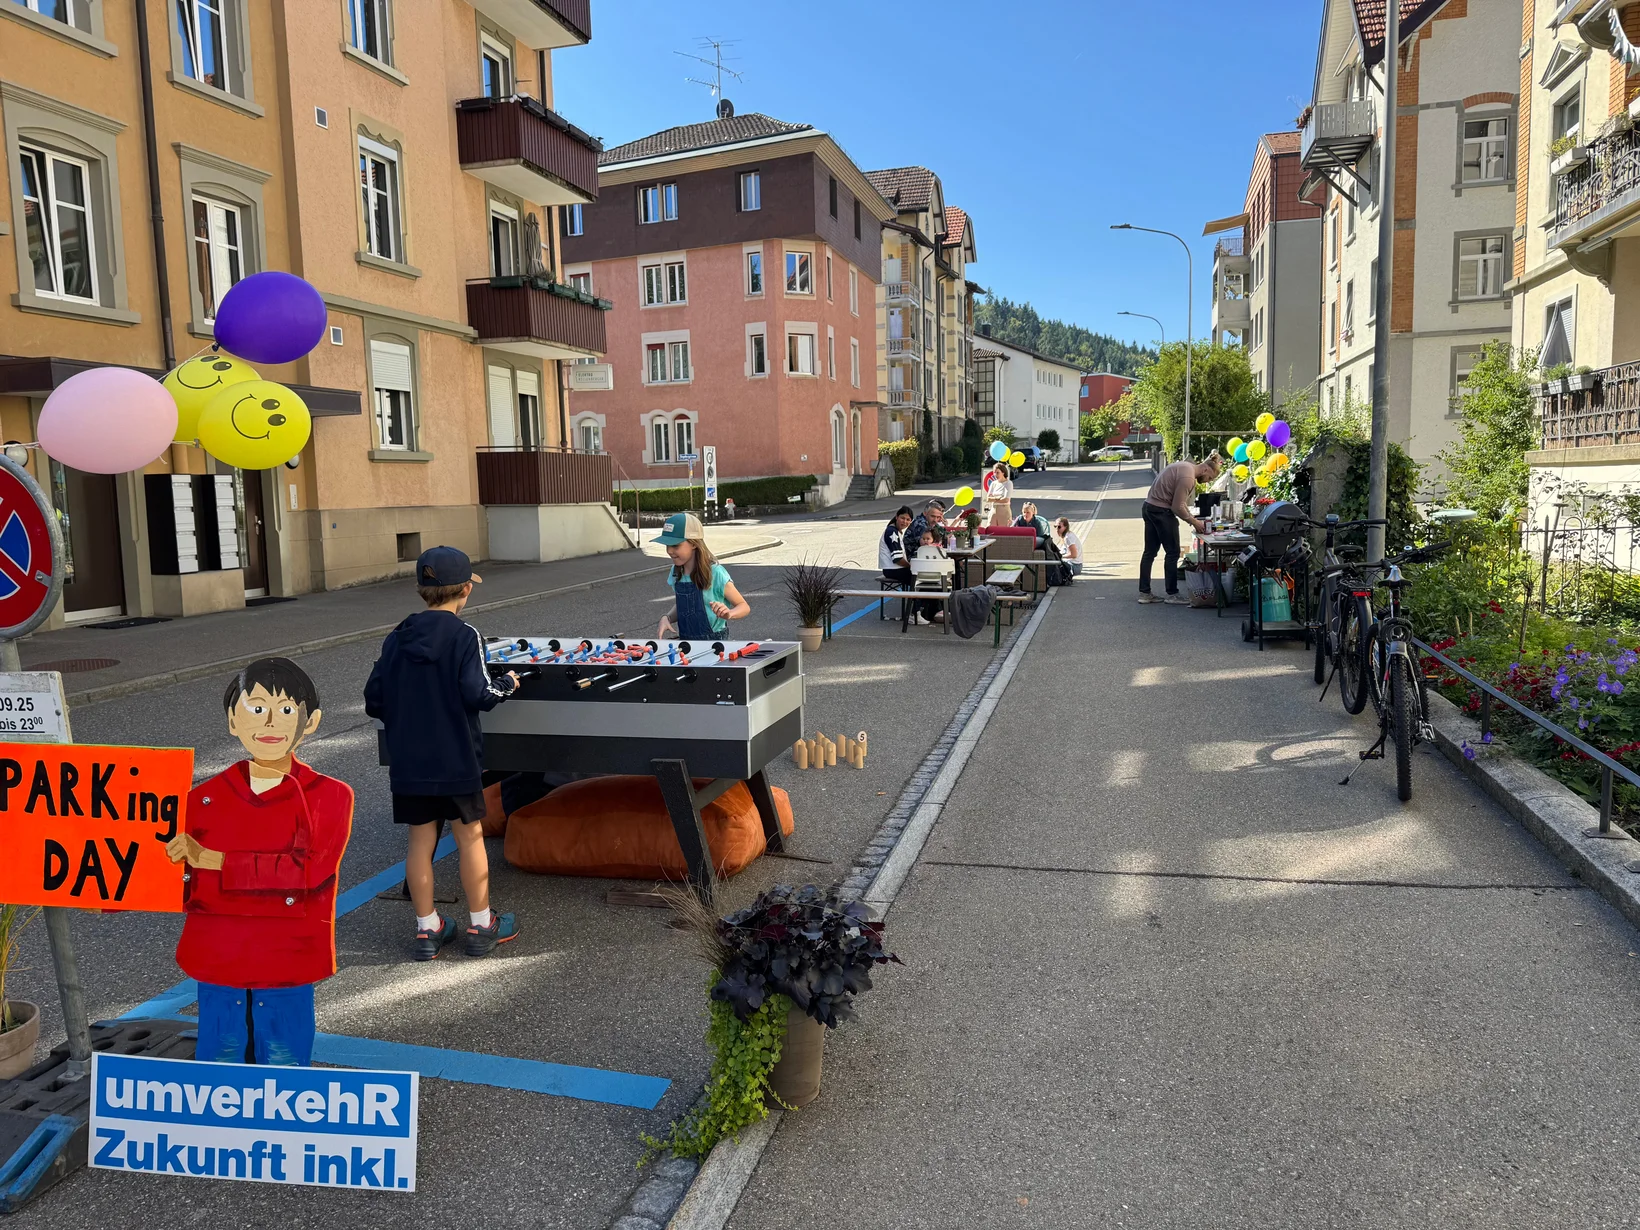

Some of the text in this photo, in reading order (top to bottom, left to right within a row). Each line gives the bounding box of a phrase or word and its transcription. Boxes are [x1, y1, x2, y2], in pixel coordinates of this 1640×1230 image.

[859, 733, 865, 741] 5
[0, 758, 178, 843] PARKing
[43, 838, 139, 901] DAY
[105, 1077, 400, 1127] umverkehR
[94, 1127, 408, 1189] Zukunft inkl.
